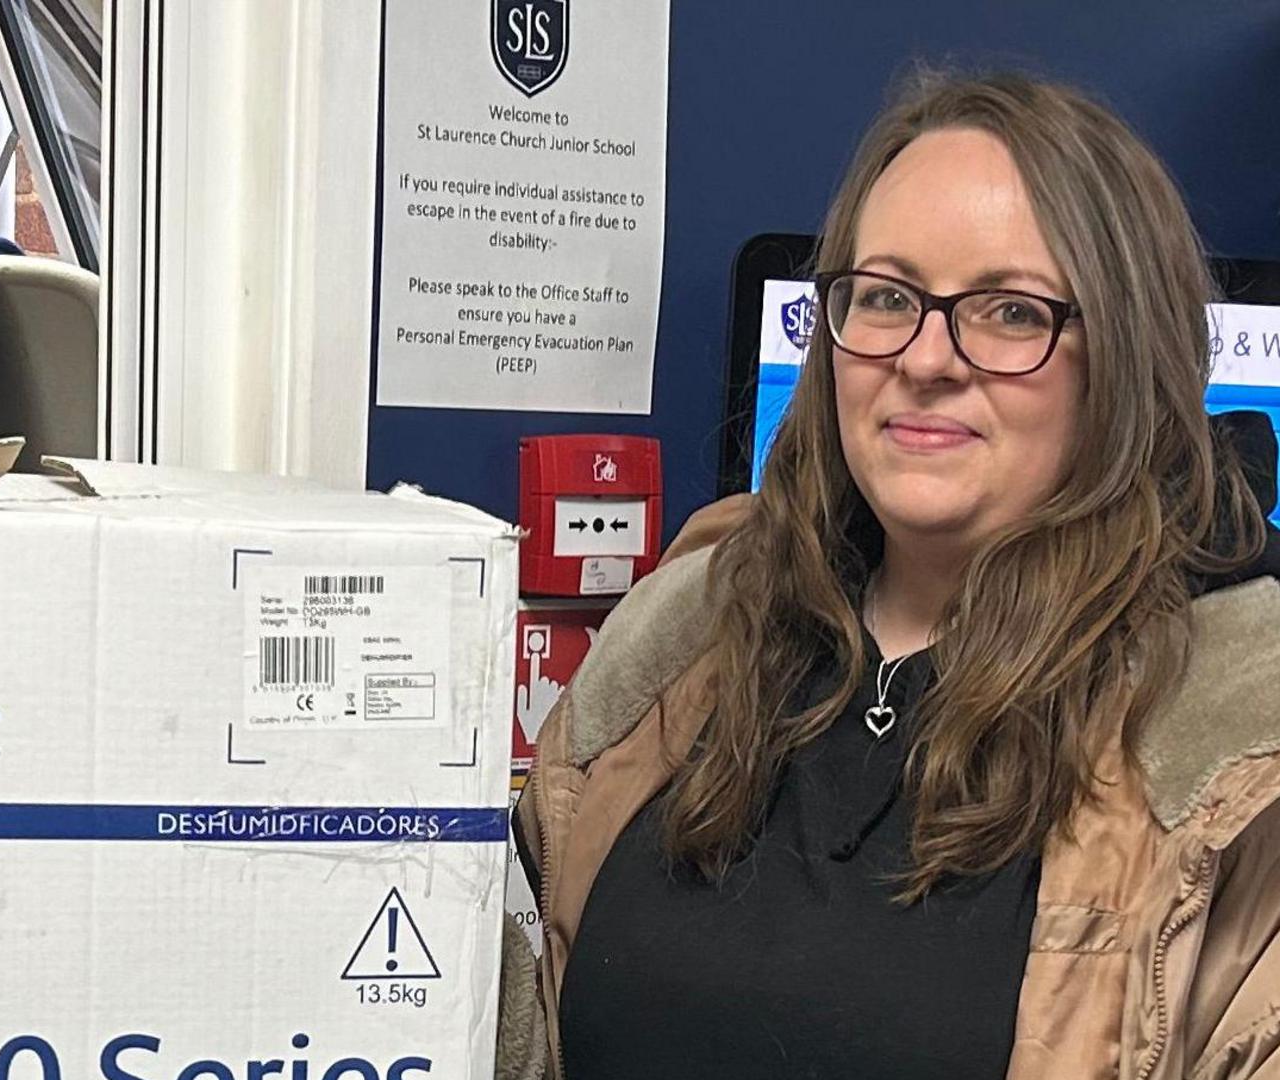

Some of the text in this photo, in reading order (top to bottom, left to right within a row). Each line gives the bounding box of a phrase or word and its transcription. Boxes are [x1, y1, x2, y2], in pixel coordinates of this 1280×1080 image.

[506, 4, 554, 61] SLS
[489, 105, 568, 126] Welcome to
[418, 124, 635, 156] St Laurence Church Junior School
[400, 174, 644, 206] If you require individual assistance to
[408, 203, 636, 230] escape in the event of a fire due to
[409, 277, 628, 303] Please speak to the Office Staff to
[458, 308, 576, 326] ensure you have a
[397, 328, 633, 352] Personal Emergency Evacuation Plan
[1233, 331, 1251, 356] &
[495, 356, 537, 374] (PEEP)
[356, 983, 427, 1007] 13.5kg
